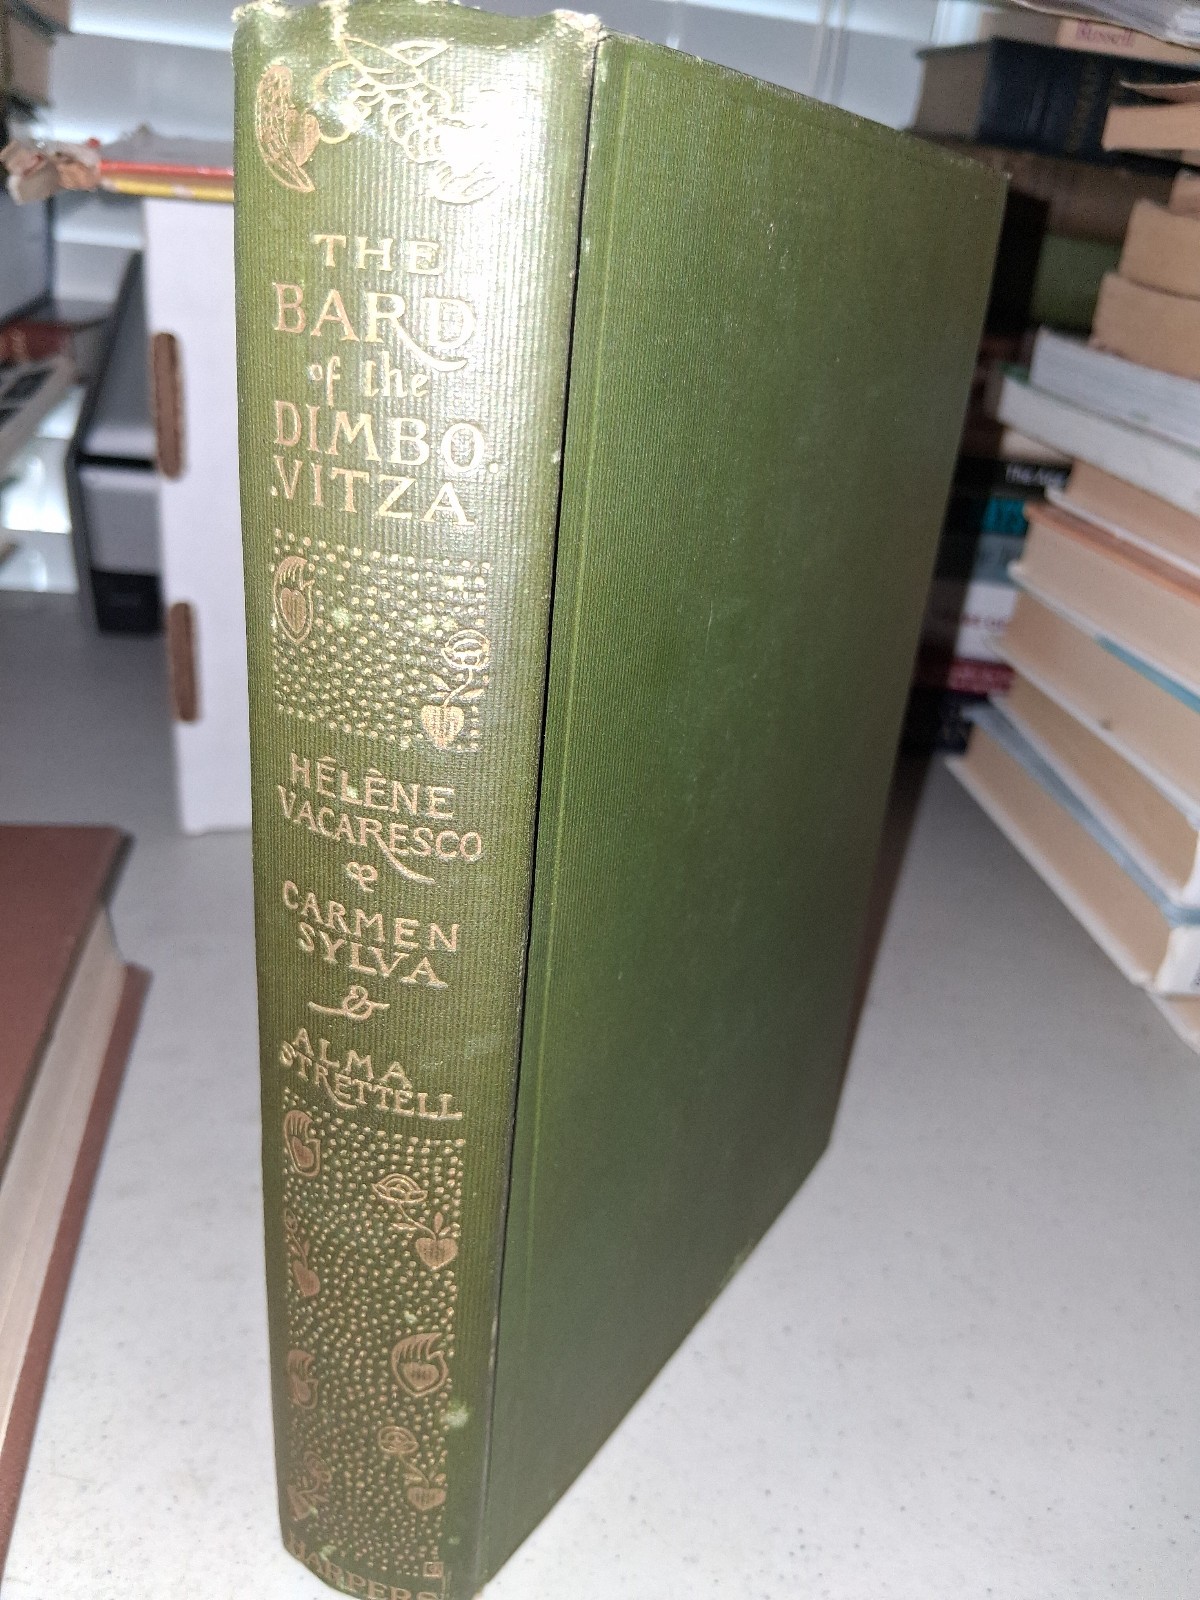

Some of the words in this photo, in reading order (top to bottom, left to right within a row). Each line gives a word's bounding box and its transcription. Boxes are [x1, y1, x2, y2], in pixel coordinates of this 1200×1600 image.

[313, 234, 445, 276] THE
[272, 281, 477, 372] BARD
[307, 355, 341, 408] of
[363, 350, 430, 399] the
[277, 784, 484, 885] VACARESCO
[282, 880, 461, 953] CARMEN
[298, 921, 449, 990] SYLVA
[292, 1027, 414, 1090] ALMA
